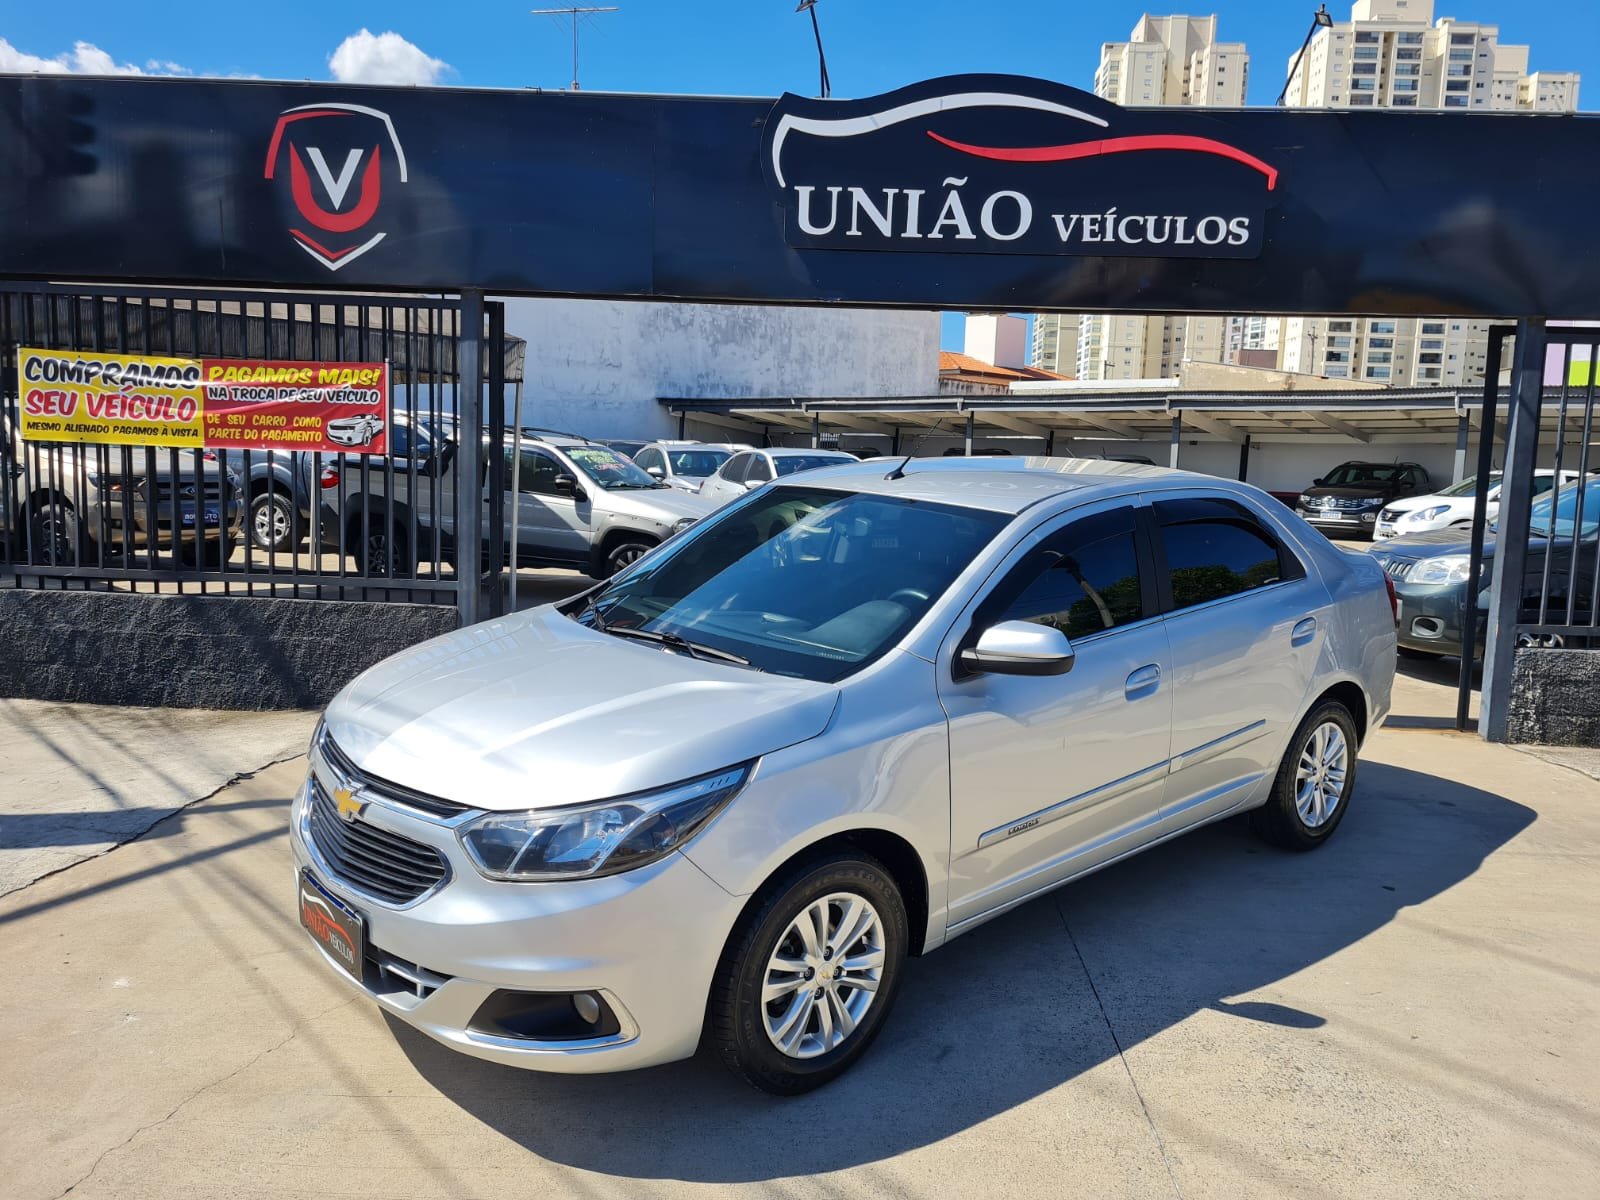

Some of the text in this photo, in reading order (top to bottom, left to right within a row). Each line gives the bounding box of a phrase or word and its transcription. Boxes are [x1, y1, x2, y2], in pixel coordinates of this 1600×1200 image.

[793, 176, 1250, 245] UNIÃO VEÍCULOS
[24, 356, 201, 389] COMPRAMOS
[208, 366, 382, 386] PAGAMOS MAIS!
[25, 384, 198, 422] SEU VEÍCULO
[208, 384, 380, 404] NA TROCA DE SEU VEÍCULO
[26, 421, 61, 432] MESMO
[64, 423, 110, 434] ALIENADO
[112, 425, 159, 436] PAGAMOS
[170, 427, 199, 438] VISTA
[206, 413, 322, 428] DE SEU CARRO COMO
[208, 428, 322, 443] PARTE DO PAGAMENTO
